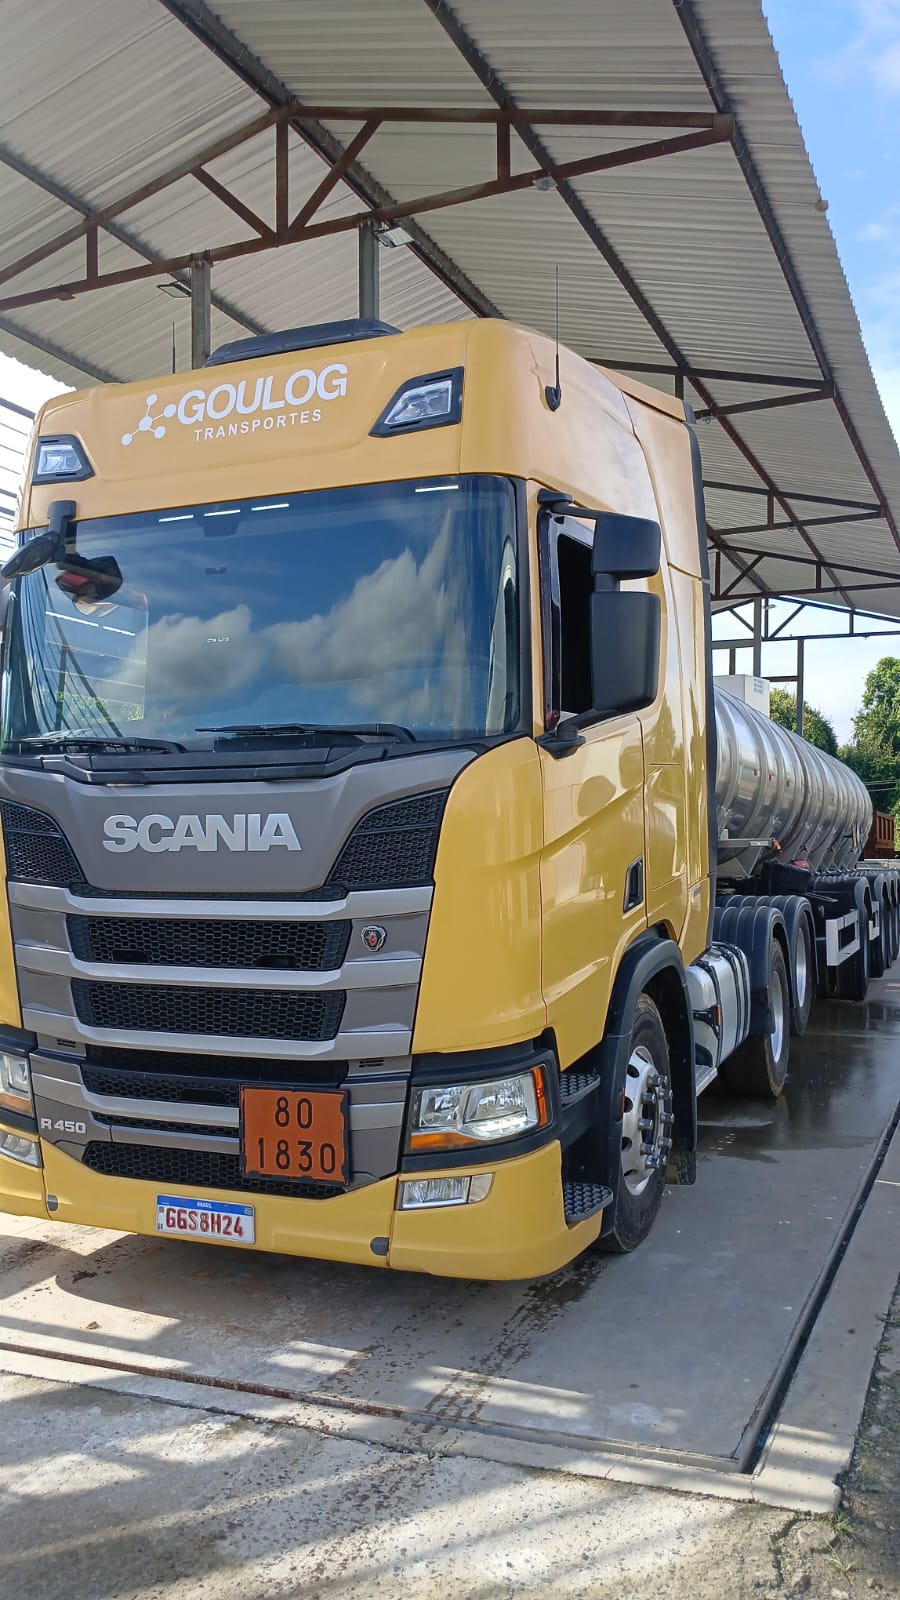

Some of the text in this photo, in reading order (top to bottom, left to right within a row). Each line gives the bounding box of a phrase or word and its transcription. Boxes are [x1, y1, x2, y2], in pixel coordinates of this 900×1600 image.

[177, 363, 348, 426] GOULOG
[194, 409, 323, 442] TRANSPORTES
[102, 813, 302, 853] SCANIA
[40, 1118, 87, 1134] R 450
[274, 1096, 313, 1129] 80
[258, 1137, 336, 1174] 1830
[196, 1201, 213, 1209] BRASIL
[165, 1207, 244, 1238] GGS8H24
